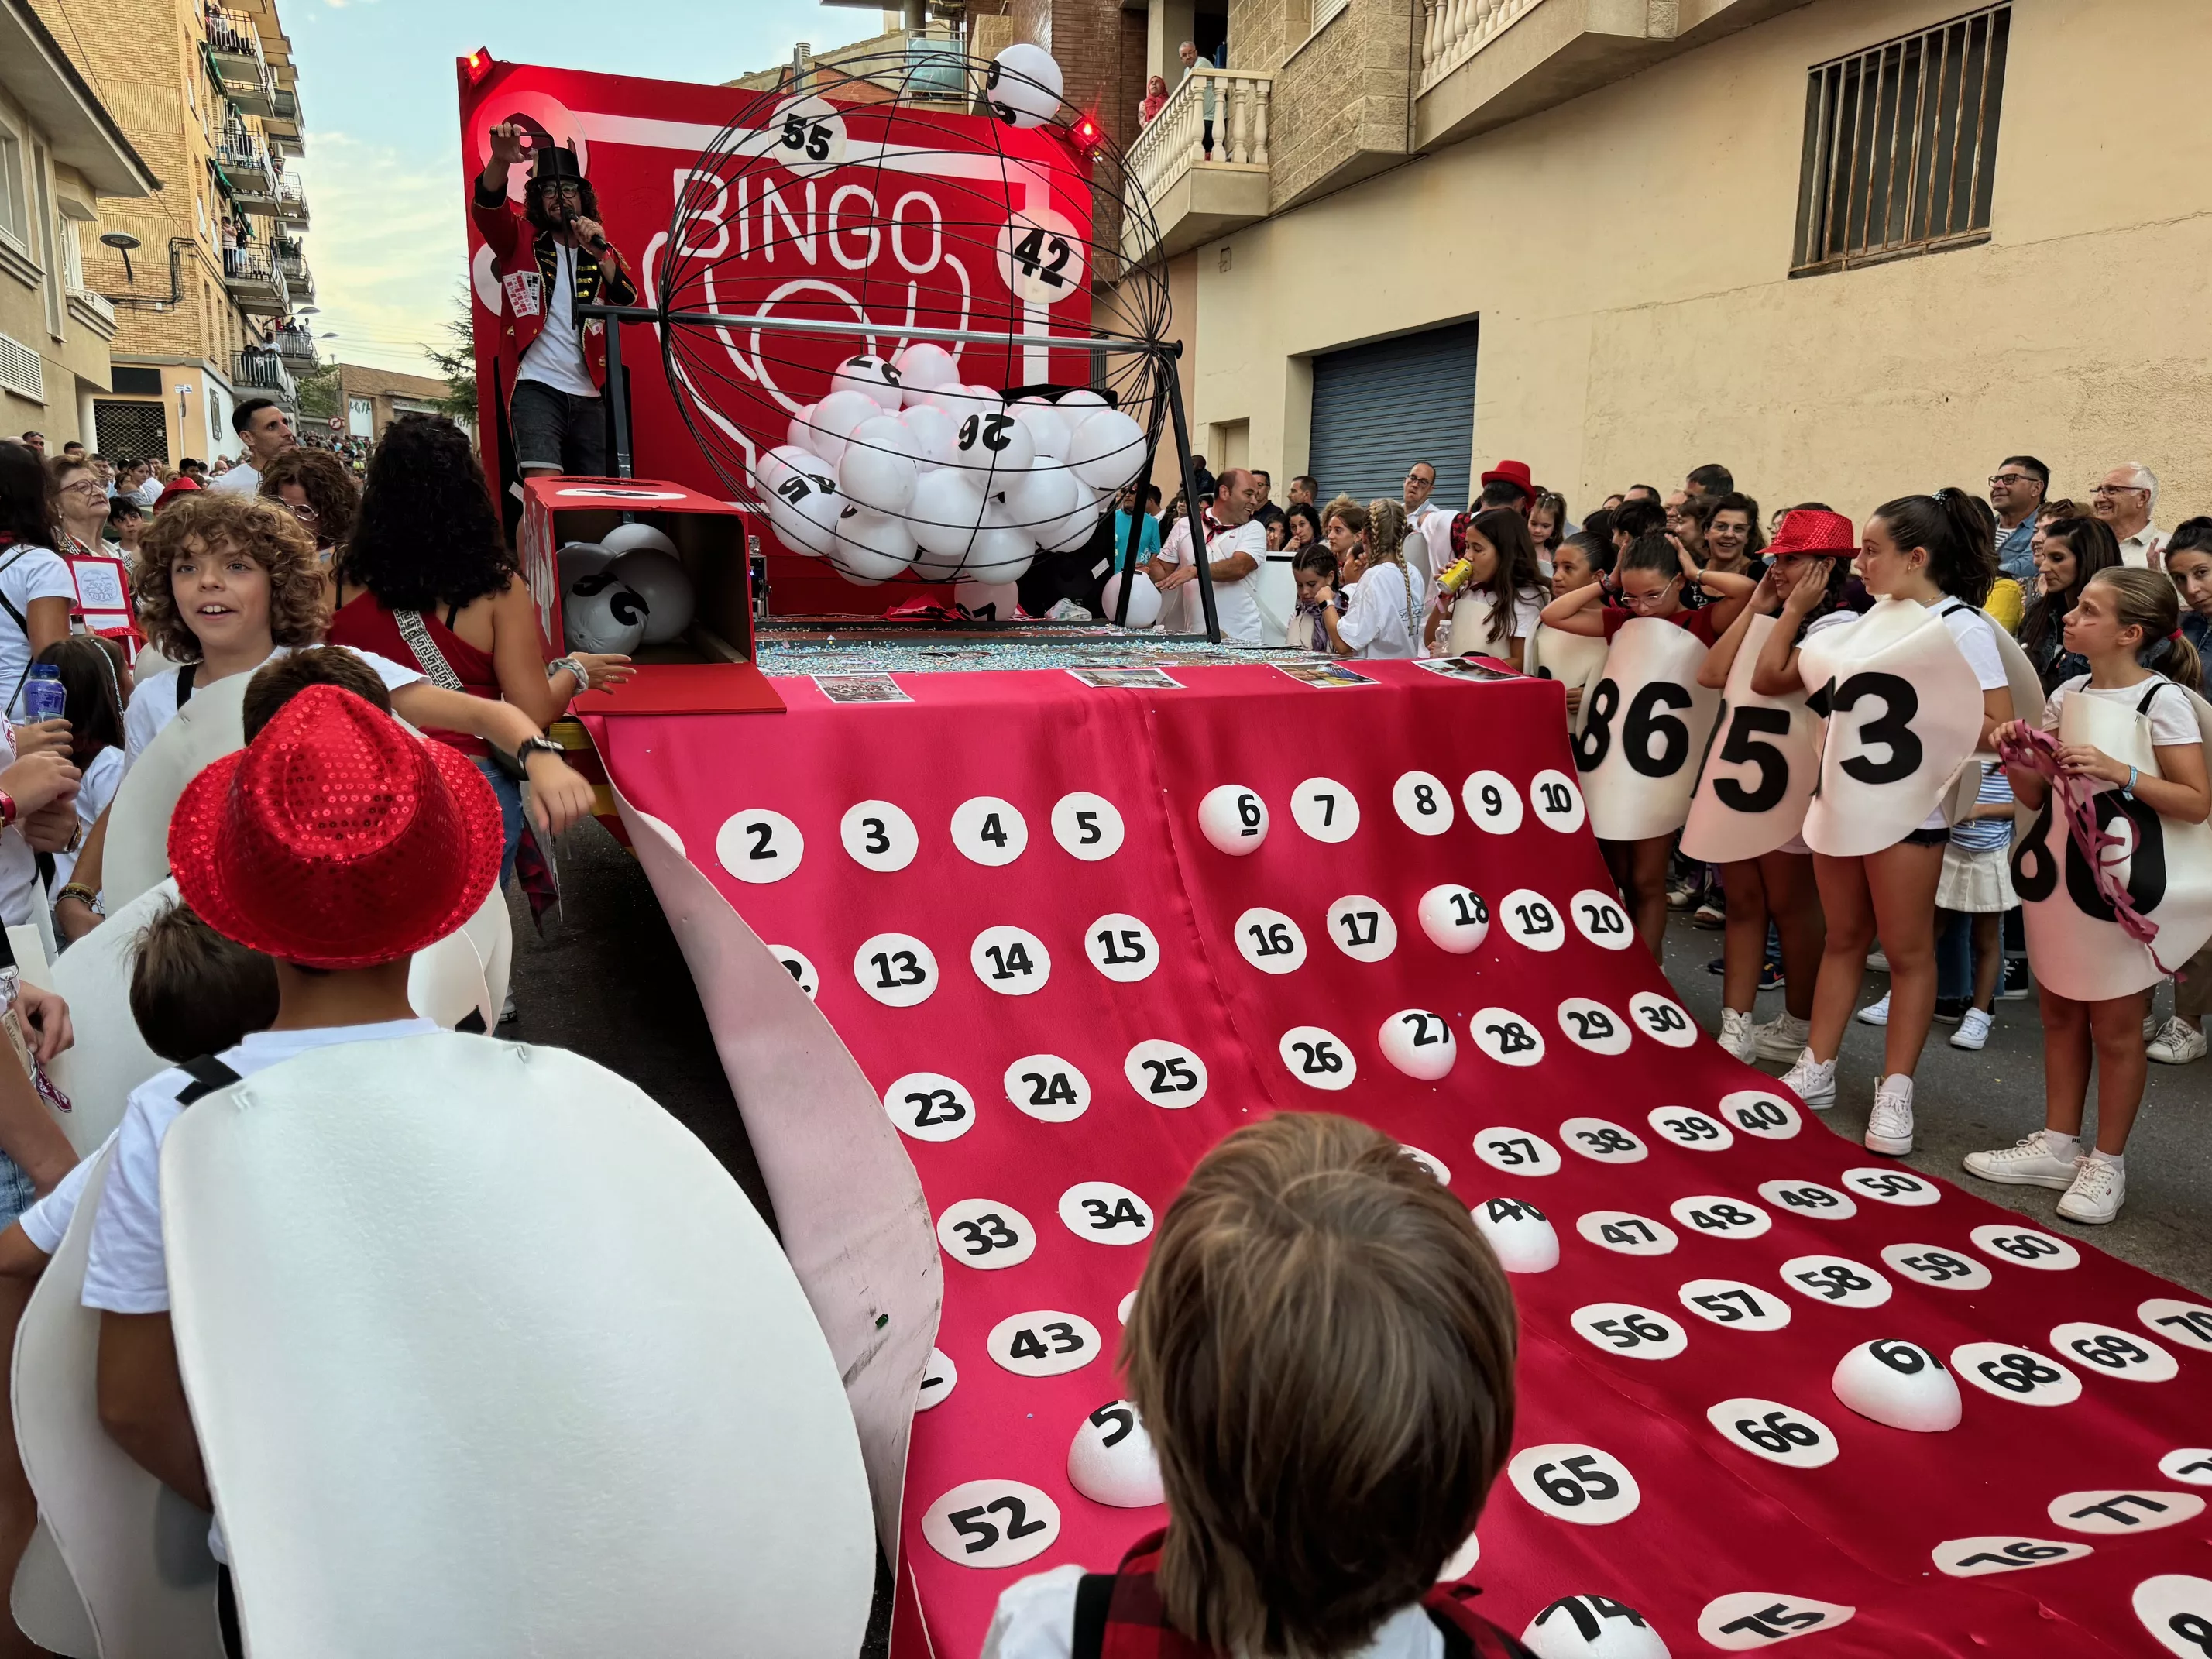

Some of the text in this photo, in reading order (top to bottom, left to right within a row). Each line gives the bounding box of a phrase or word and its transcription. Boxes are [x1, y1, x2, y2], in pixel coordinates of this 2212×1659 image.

[781, 112, 833, 162] 55
[673, 168, 942, 273] BINGO
[1013, 228, 1072, 288] 42
[1575, 678, 1692, 778] 86
[1238, 794, 1261, 827] 6
[1314, 795, 1334, 826] 7
[1415, 785, 1437, 815] 8
[1482, 785, 1502, 816] 9
[1540, 783, 1571, 812] 10
[747, 823, 777, 859] 2
[863, 818, 890, 854] 3
[981, 813, 1007, 847] 4
[1076, 812, 1101, 843] 5
[2011, 788, 2167, 923] 60
[1450, 892, 1488, 926] 18
[1516, 903, 1554, 934] 19
[1582, 905, 1624, 934] 20
[1249, 924, 1293, 956] 16
[1340, 912, 1378, 946] 17
[986, 943, 1033, 979] 14
[1097, 931, 1146, 964] 15
[871, 951, 926, 988] 13
[1402, 1014, 1449, 1046] 27
[1567, 1011, 1613, 1039] 29
[1640, 1005, 1686, 1032] 30
[1486, 1023, 1536, 1054] 28
[1292, 1042, 1342, 1073] 26
[1022, 1073, 1077, 1105] 24
[1142, 1057, 1197, 1093] 25
[905, 1090, 966, 1127] 23
[1736, 1101, 1788, 1130] 40
[1576, 1129, 1636, 1153] 38
[1664, 1117, 1719, 1141] 39
[1489, 1139, 1540, 1164] 37
[1779, 1188, 1838, 1208] 49
[1856, 1174, 1922, 1197] 50
[1082, 1198, 1146, 1229] 34
[1689, 1205, 1755, 1229] 48
[953, 1214, 1018, 1255] 33
[1601, 1220, 1657, 1244] 47
[1992, 1234, 2060, 1259] 60
[1795, 1266, 1871, 1299] 58
[1901, 1253, 1971, 1280] 59
[1692, 1290, 1765, 1321] 57
[1010, 1323, 1084, 1359] 43
[1590, 1314, 1668, 1347] 56
[2071, 1336, 2148, 1368] 69
[1978, 1354, 2061, 1393] 68
[1089, 1400, 1134, 1448] 5
[1736, 1412, 1819, 1452] 66
[1534, 1455, 1619, 1506] 65
[948, 1496, 1046, 1554] 52
[2069, 1494, 2169, 1526] 77
[1956, 1543, 2068, 1566] 76
[1535, 1593, 1647, 1642] 74
[1719, 1602, 1826, 1639] 75
